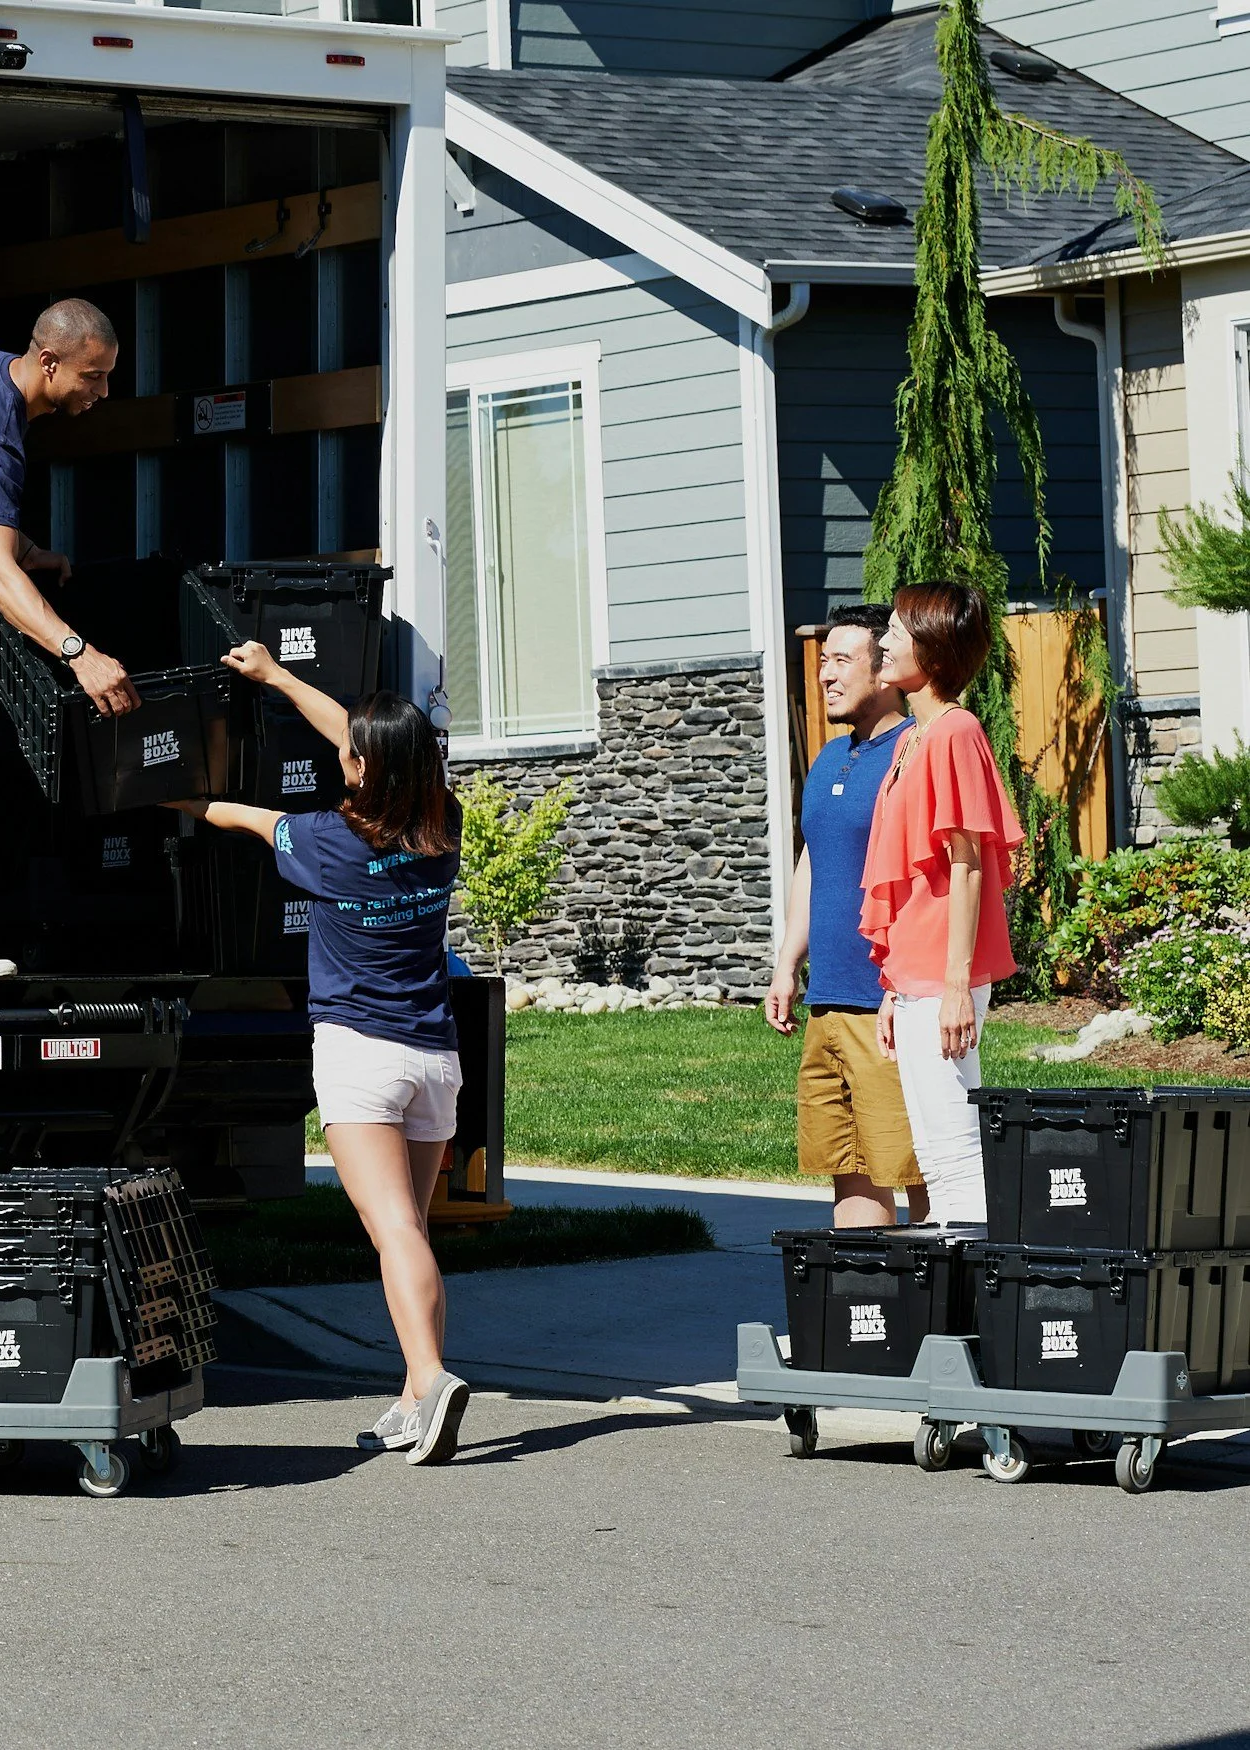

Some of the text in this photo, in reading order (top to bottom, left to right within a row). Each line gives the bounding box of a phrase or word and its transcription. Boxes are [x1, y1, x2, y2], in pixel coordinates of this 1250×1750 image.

[280, 627, 312, 641] HIVE
[279, 640, 316, 654] BOXX
[142, 730, 174, 748] HIVE
[142, 741, 180, 760] BOXX
[282, 760, 312, 773] HIVE
[282, 772, 317, 786] BOXX
[104, 836, 128, 848] HIVE
[103, 848, 130, 860] BOXX
[367, 896, 396, 911] rent
[363, 897, 448, 927] moving boxes
[283, 913, 309, 927] BOX
[47, 1040, 95, 1058] WALTCO
[1049, 1168, 1082, 1183] HIVE
[1049, 1183, 1087, 1198] BOXX
[849, 1304, 881, 1319] HIVE
[850, 1319, 886, 1334] BOXX
[1041, 1320, 1073, 1336] HIVE
[1041, 1335, 1078, 1350] BOXX
